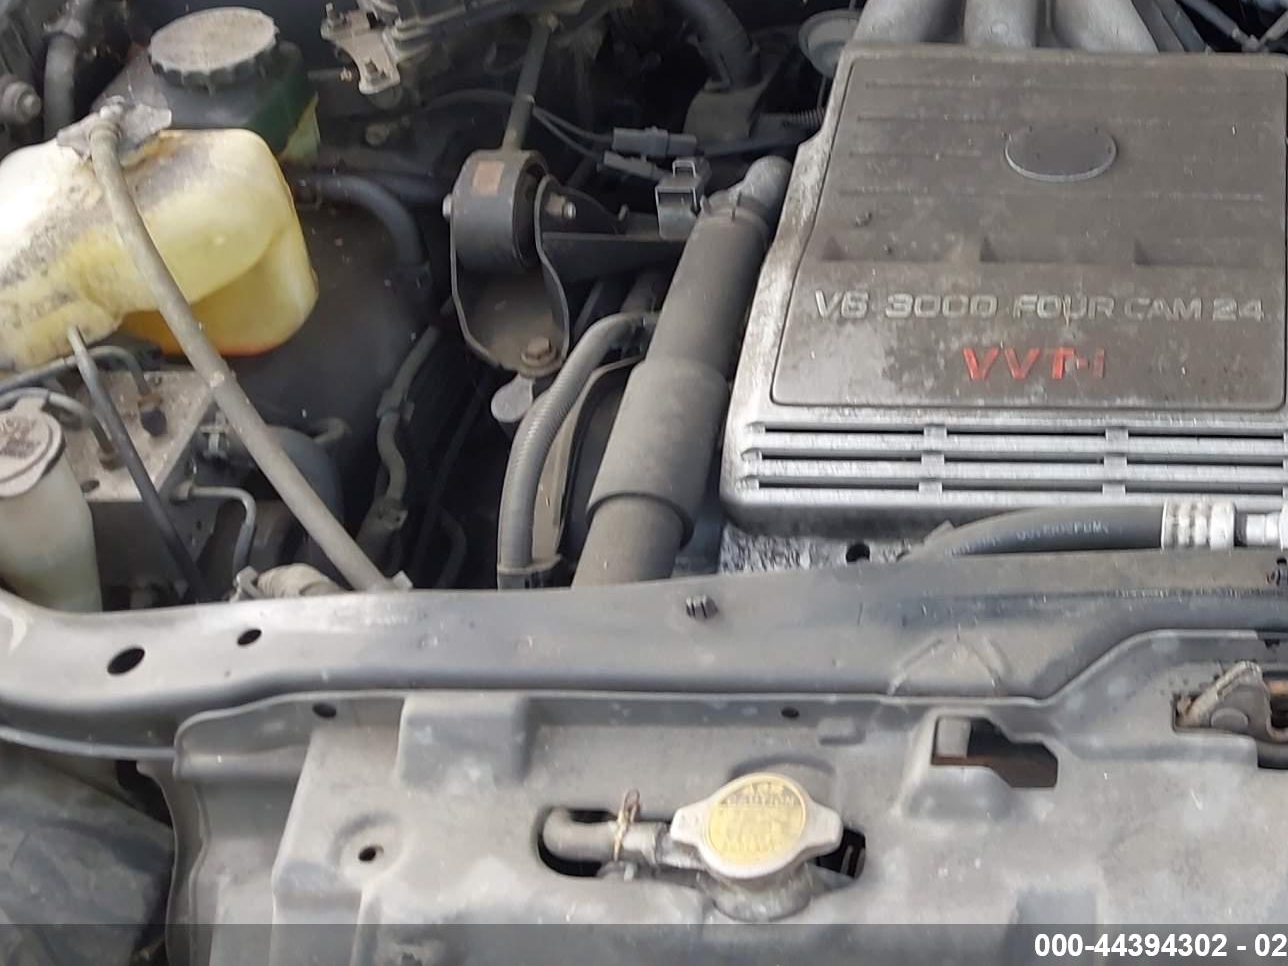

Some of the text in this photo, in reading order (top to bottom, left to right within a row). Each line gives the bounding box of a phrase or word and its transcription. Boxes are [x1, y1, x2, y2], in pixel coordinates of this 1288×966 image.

[814, 289, 1265, 322] V6 3000 FOUR CAM 24
